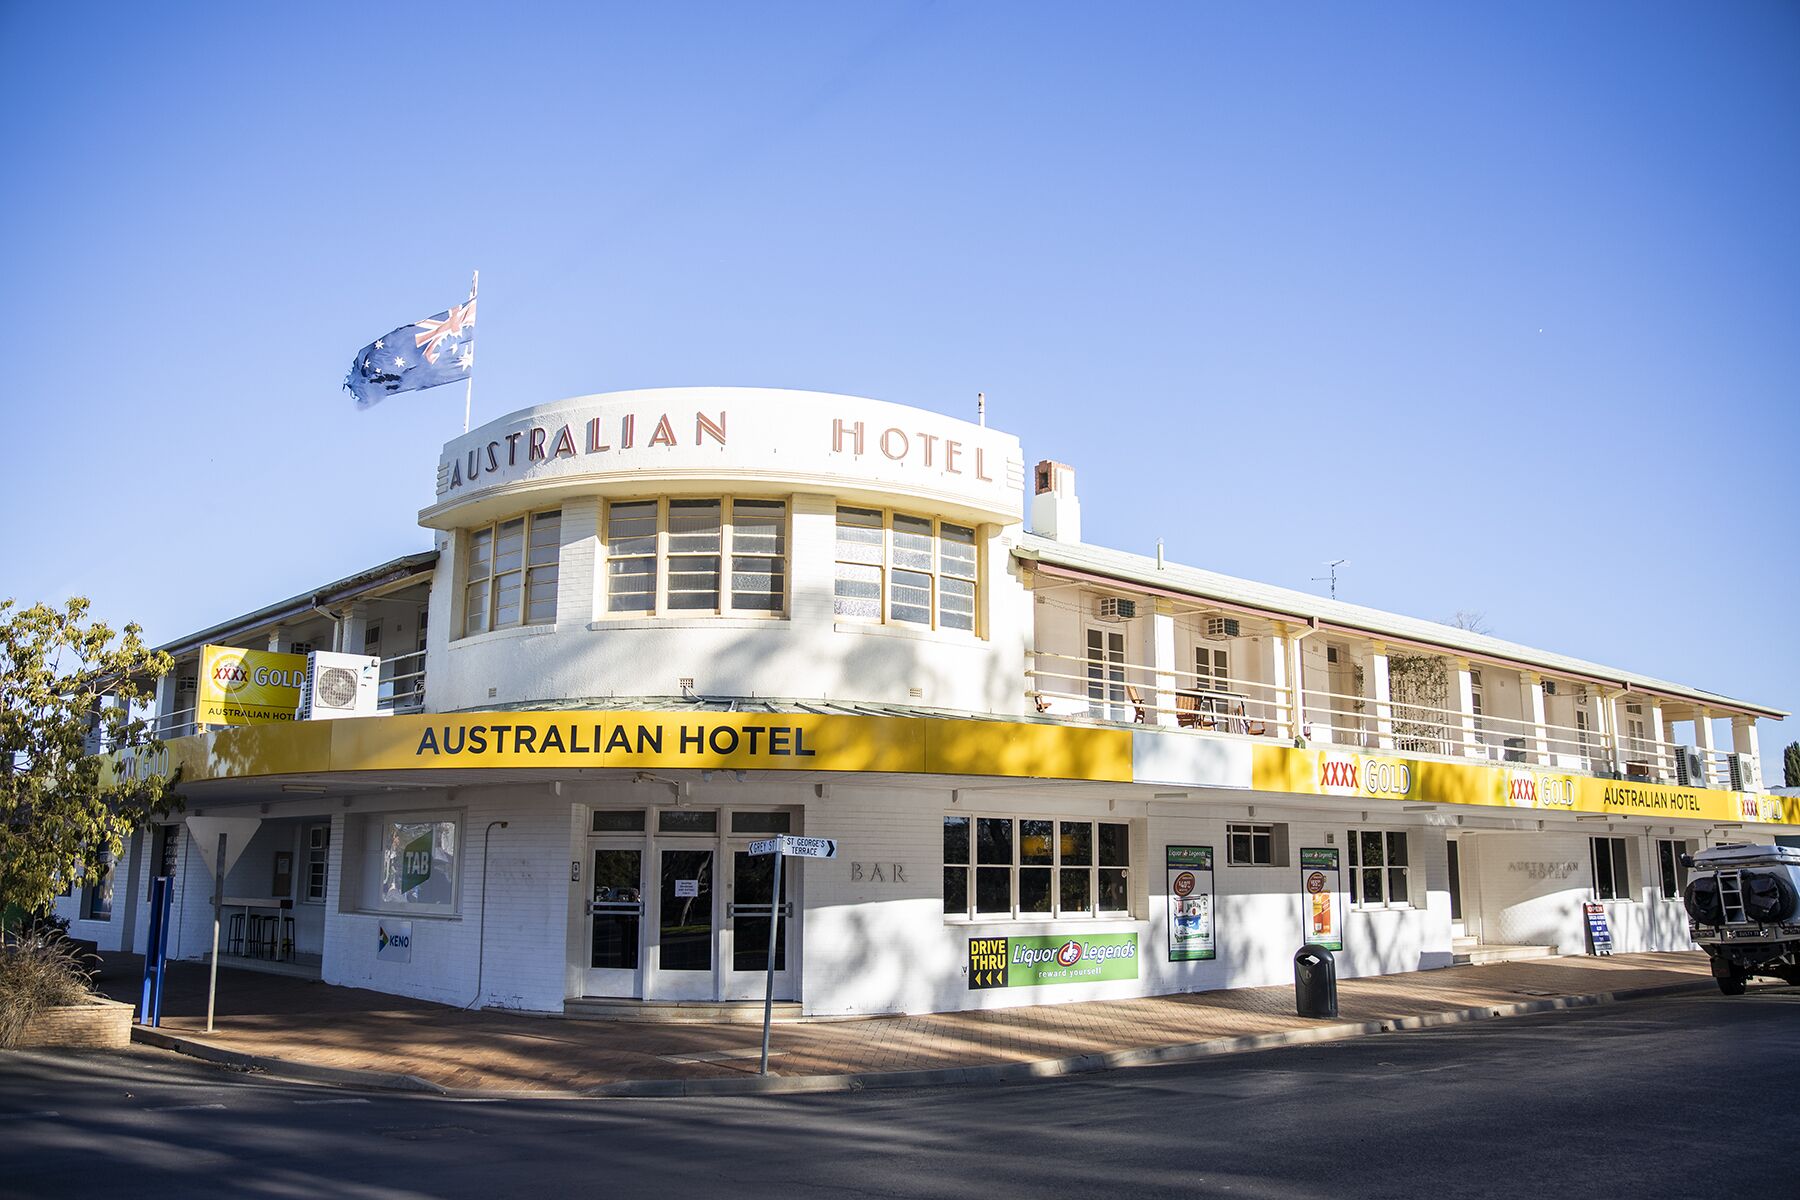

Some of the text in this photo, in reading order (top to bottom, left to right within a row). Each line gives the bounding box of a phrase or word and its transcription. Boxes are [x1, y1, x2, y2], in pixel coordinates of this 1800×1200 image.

[449, 410, 993, 490] AUSTRALIAN HOTEL
[213, 666, 305, 689] XXXX GOLD
[208, 708, 297, 721] AUSTRALIAN HOTE
[416, 724, 816, 757] AUSTRALIAN HOTEL
[1320, 759, 1411, 795] XXXX GOLD
[1509, 776, 1575, 806] XXXX GOLD
[1603, 786, 1700, 812] AUSTRALIAN HOTEL
[1741, 797, 1782, 820] XXXX GOLD
[753, 839, 776, 853] GREY ST
[786, 837, 825, 848] ST GEORGE'S
[791, 846, 817, 856] TERRACE
[405, 851, 430, 875] TAB
[851, 861, 908, 883] BAR
[1508, 861, 1579, 872] AUSTRALIAN
[1528, 870, 1568, 880] HOTEL
[389, 935, 409, 948] KENO
[971, 940, 1006, 955] DRIVE
[971, 954, 1006, 971] THRU
[1012, 940, 1136, 968] Liquor Legends
[1038, 967, 1102, 978] reward yourself
